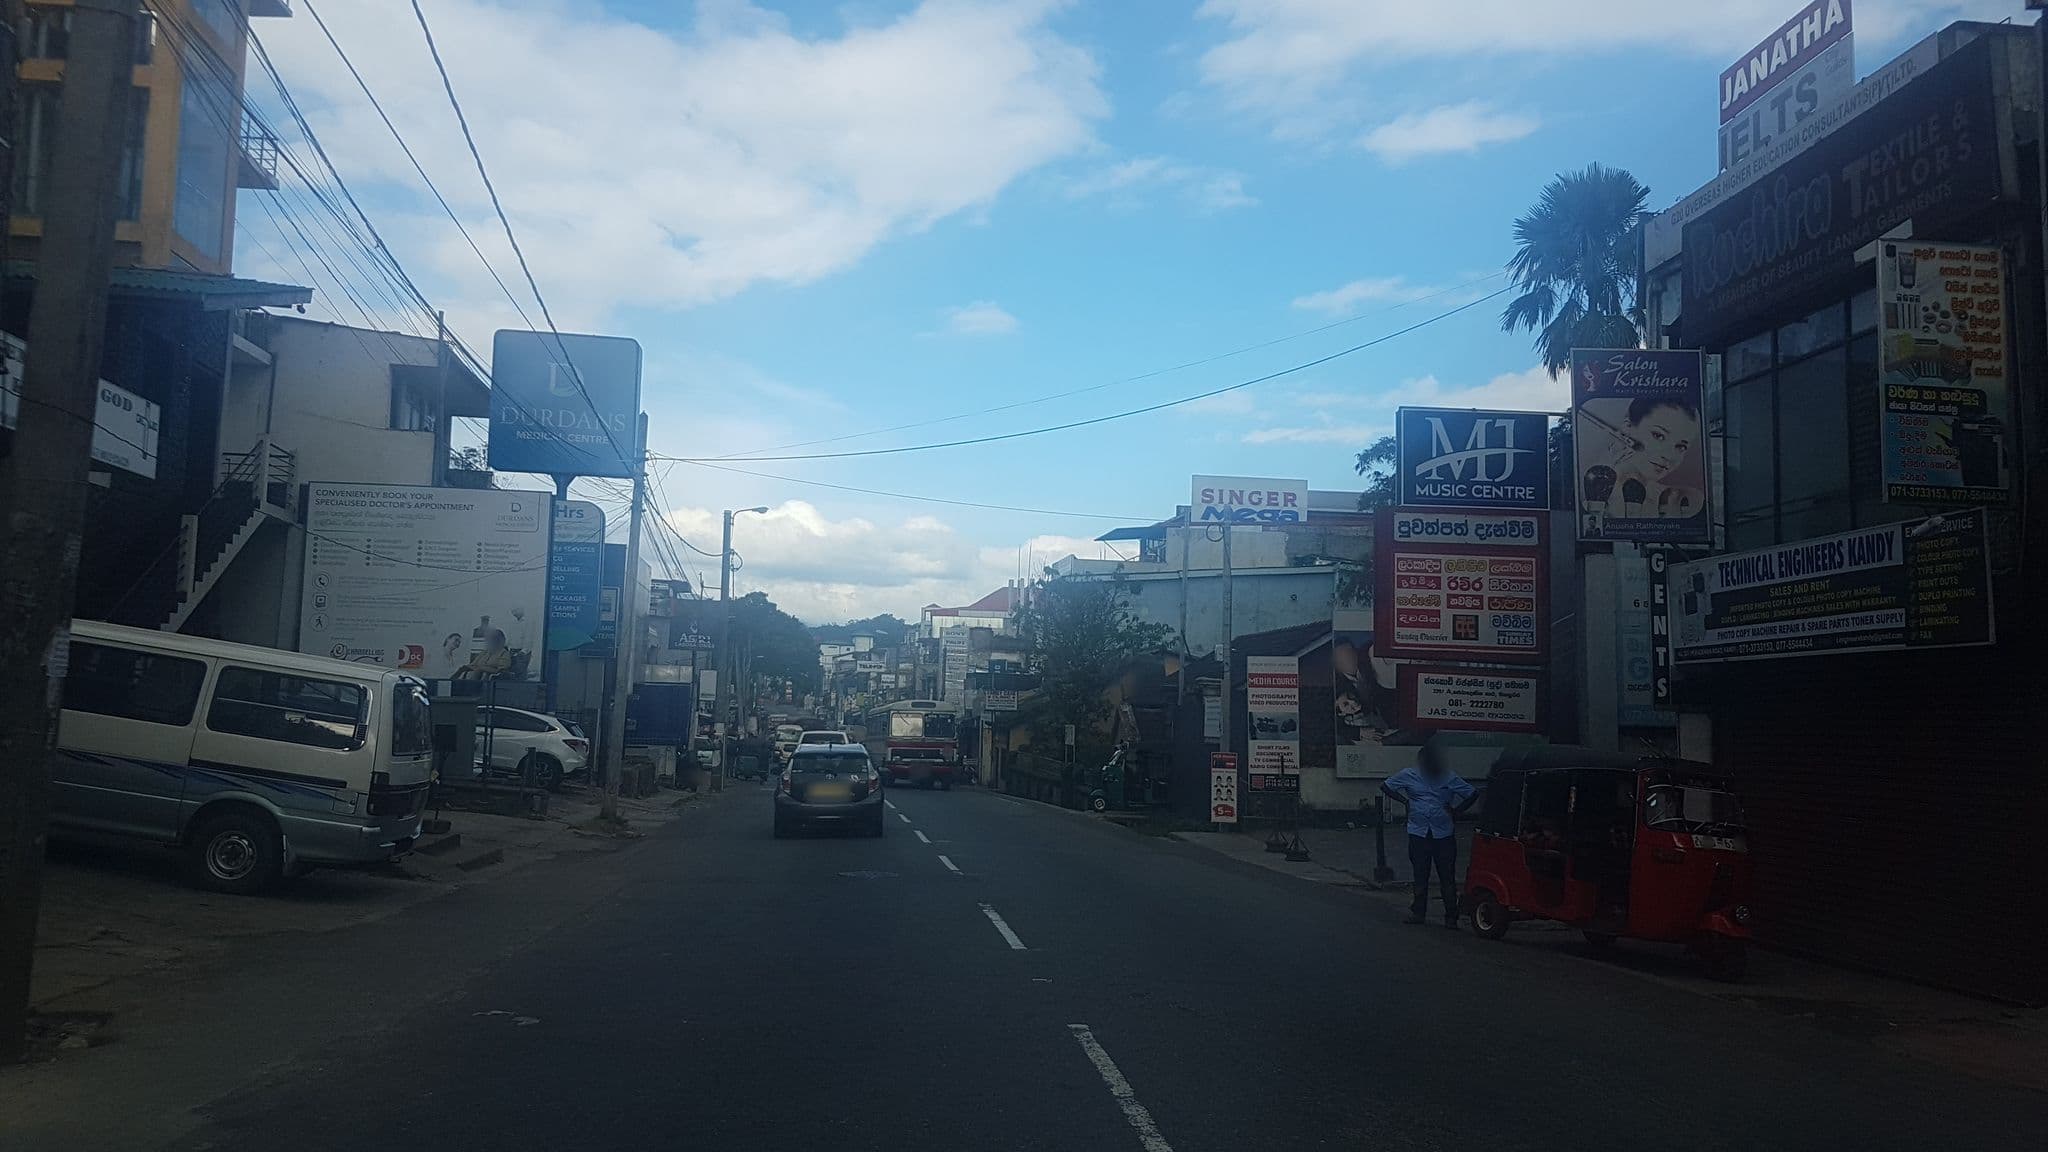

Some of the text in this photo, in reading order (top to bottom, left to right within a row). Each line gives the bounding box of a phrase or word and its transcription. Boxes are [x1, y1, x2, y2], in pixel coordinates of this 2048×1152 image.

[1722, 0, 1845, 111] JANATHA
[1720, 72, 1818, 173] IELTS
[1685, 182, 1721, 216] OVERSEAS
[1722, 160, 1752, 194] HIGHER
[1753, 135, 1800, 182] EDUCATION
[1602, 353, 1659, 375] Salon
[1613, 371, 1689, 388] Krishara
[100, 388, 134, 412] GOD
[502, 406, 627, 432] DURDANS
[516, 430, 610, 445] MEDICAL CENTRE
[1424, 416, 1516, 483] MJ
[315, 489, 434, 501] CONVENIENTLY BOOK YOUR
[1201, 487, 1297, 508] SINGER
[1416, 484, 1536, 500] MUSIC CENTRE
[314, 498, 367, 508] SPECIALISED
[414, 502, 475, 512] APPOINTMENT
[556, 504, 585, 519] Hrs
[1200, 505, 1299, 525] Mega
[1398, 518, 1469, 539] පුවත්පත්
[1718, 551, 1775, 588] TECHNICAL
[1777, 539, 1845, 579] ENGINEERS
[1847, 530, 1896, 566] KANDY
[1769, 585, 1793, 598] SALES
[1794, 582, 1809, 595] AND
[1651, 552, 1669, 698] GENTS
[1718, 630, 1736, 641] PHOTO
[1737, 628, 1751, 639] COPY
[1752, 625, 1778, 637] MACHINE
[1779, 622, 1800, 634] REPAIR
[1807, 618, 1828, 631] SPARE
[1830, 616, 1850, 629] PARTS
[1852, 613, 1874, 627] TONER
[1876, 611, 1905, 625] SUPPLY
[1501, 635, 1534, 646] TIMES
[1248, 677, 1298, 686] MEDIA COURSE
[1427, 707, 1448, 716] JAS
